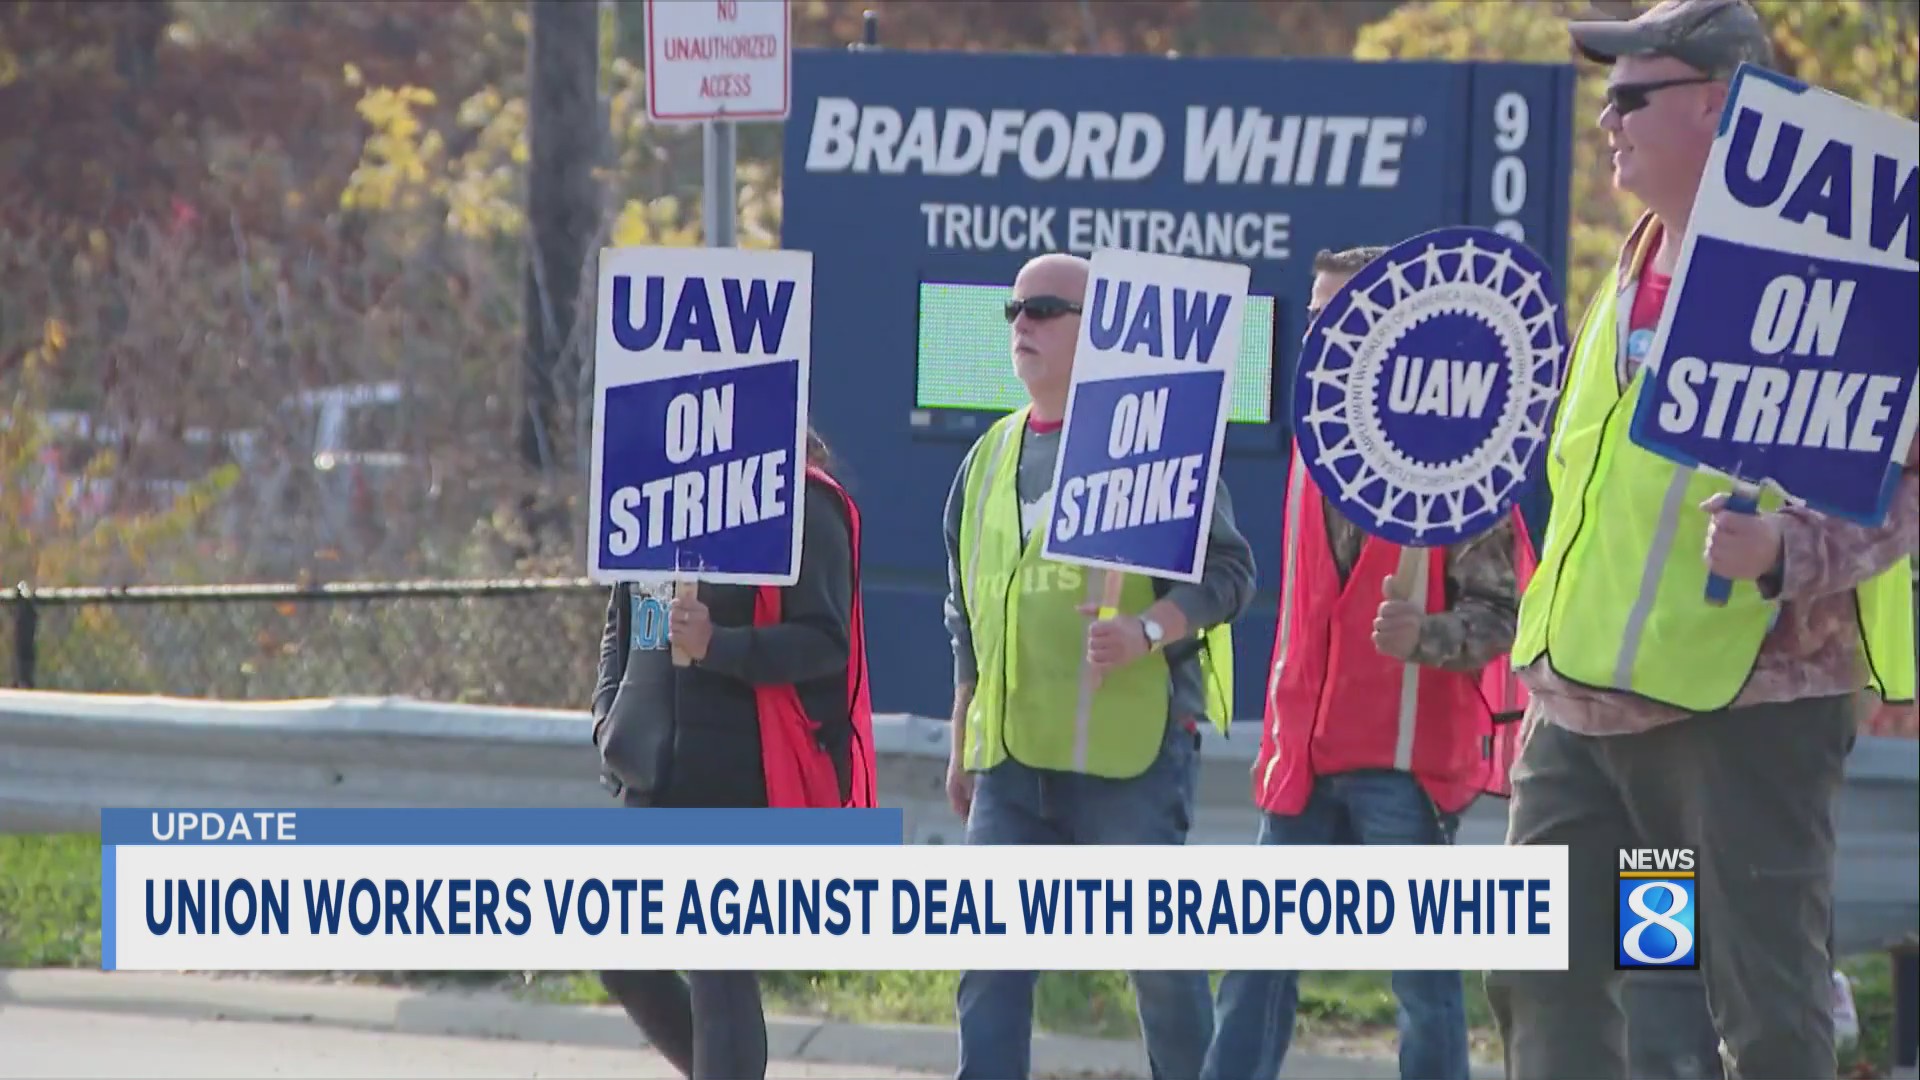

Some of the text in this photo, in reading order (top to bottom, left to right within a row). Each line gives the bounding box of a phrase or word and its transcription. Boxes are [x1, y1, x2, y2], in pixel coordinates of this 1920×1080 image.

[664, 35, 777, 60] UNAUTHORIZED
[717, 0, 737, 21] NO
[701, 74, 751, 97] ACCESS
[806, 98, 1164, 180] BRADFORD
[921, 203, 1290, 259] TRUCK ENTRANCE
[612, 276, 795, 354] UAW
[1090, 279, 1233, 364] UAW
[1751, 275, 1856, 356] ON
[666, 384, 735, 464] ON
[1109, 388, 1168, 460] ON
[1389, 356, 1500, 418] UAW
[1659, 357, 1900, 452] STRIKE
[609, 450, 787, 557] STRIKE
[1056, 454, 1202, 542] STRIKE
